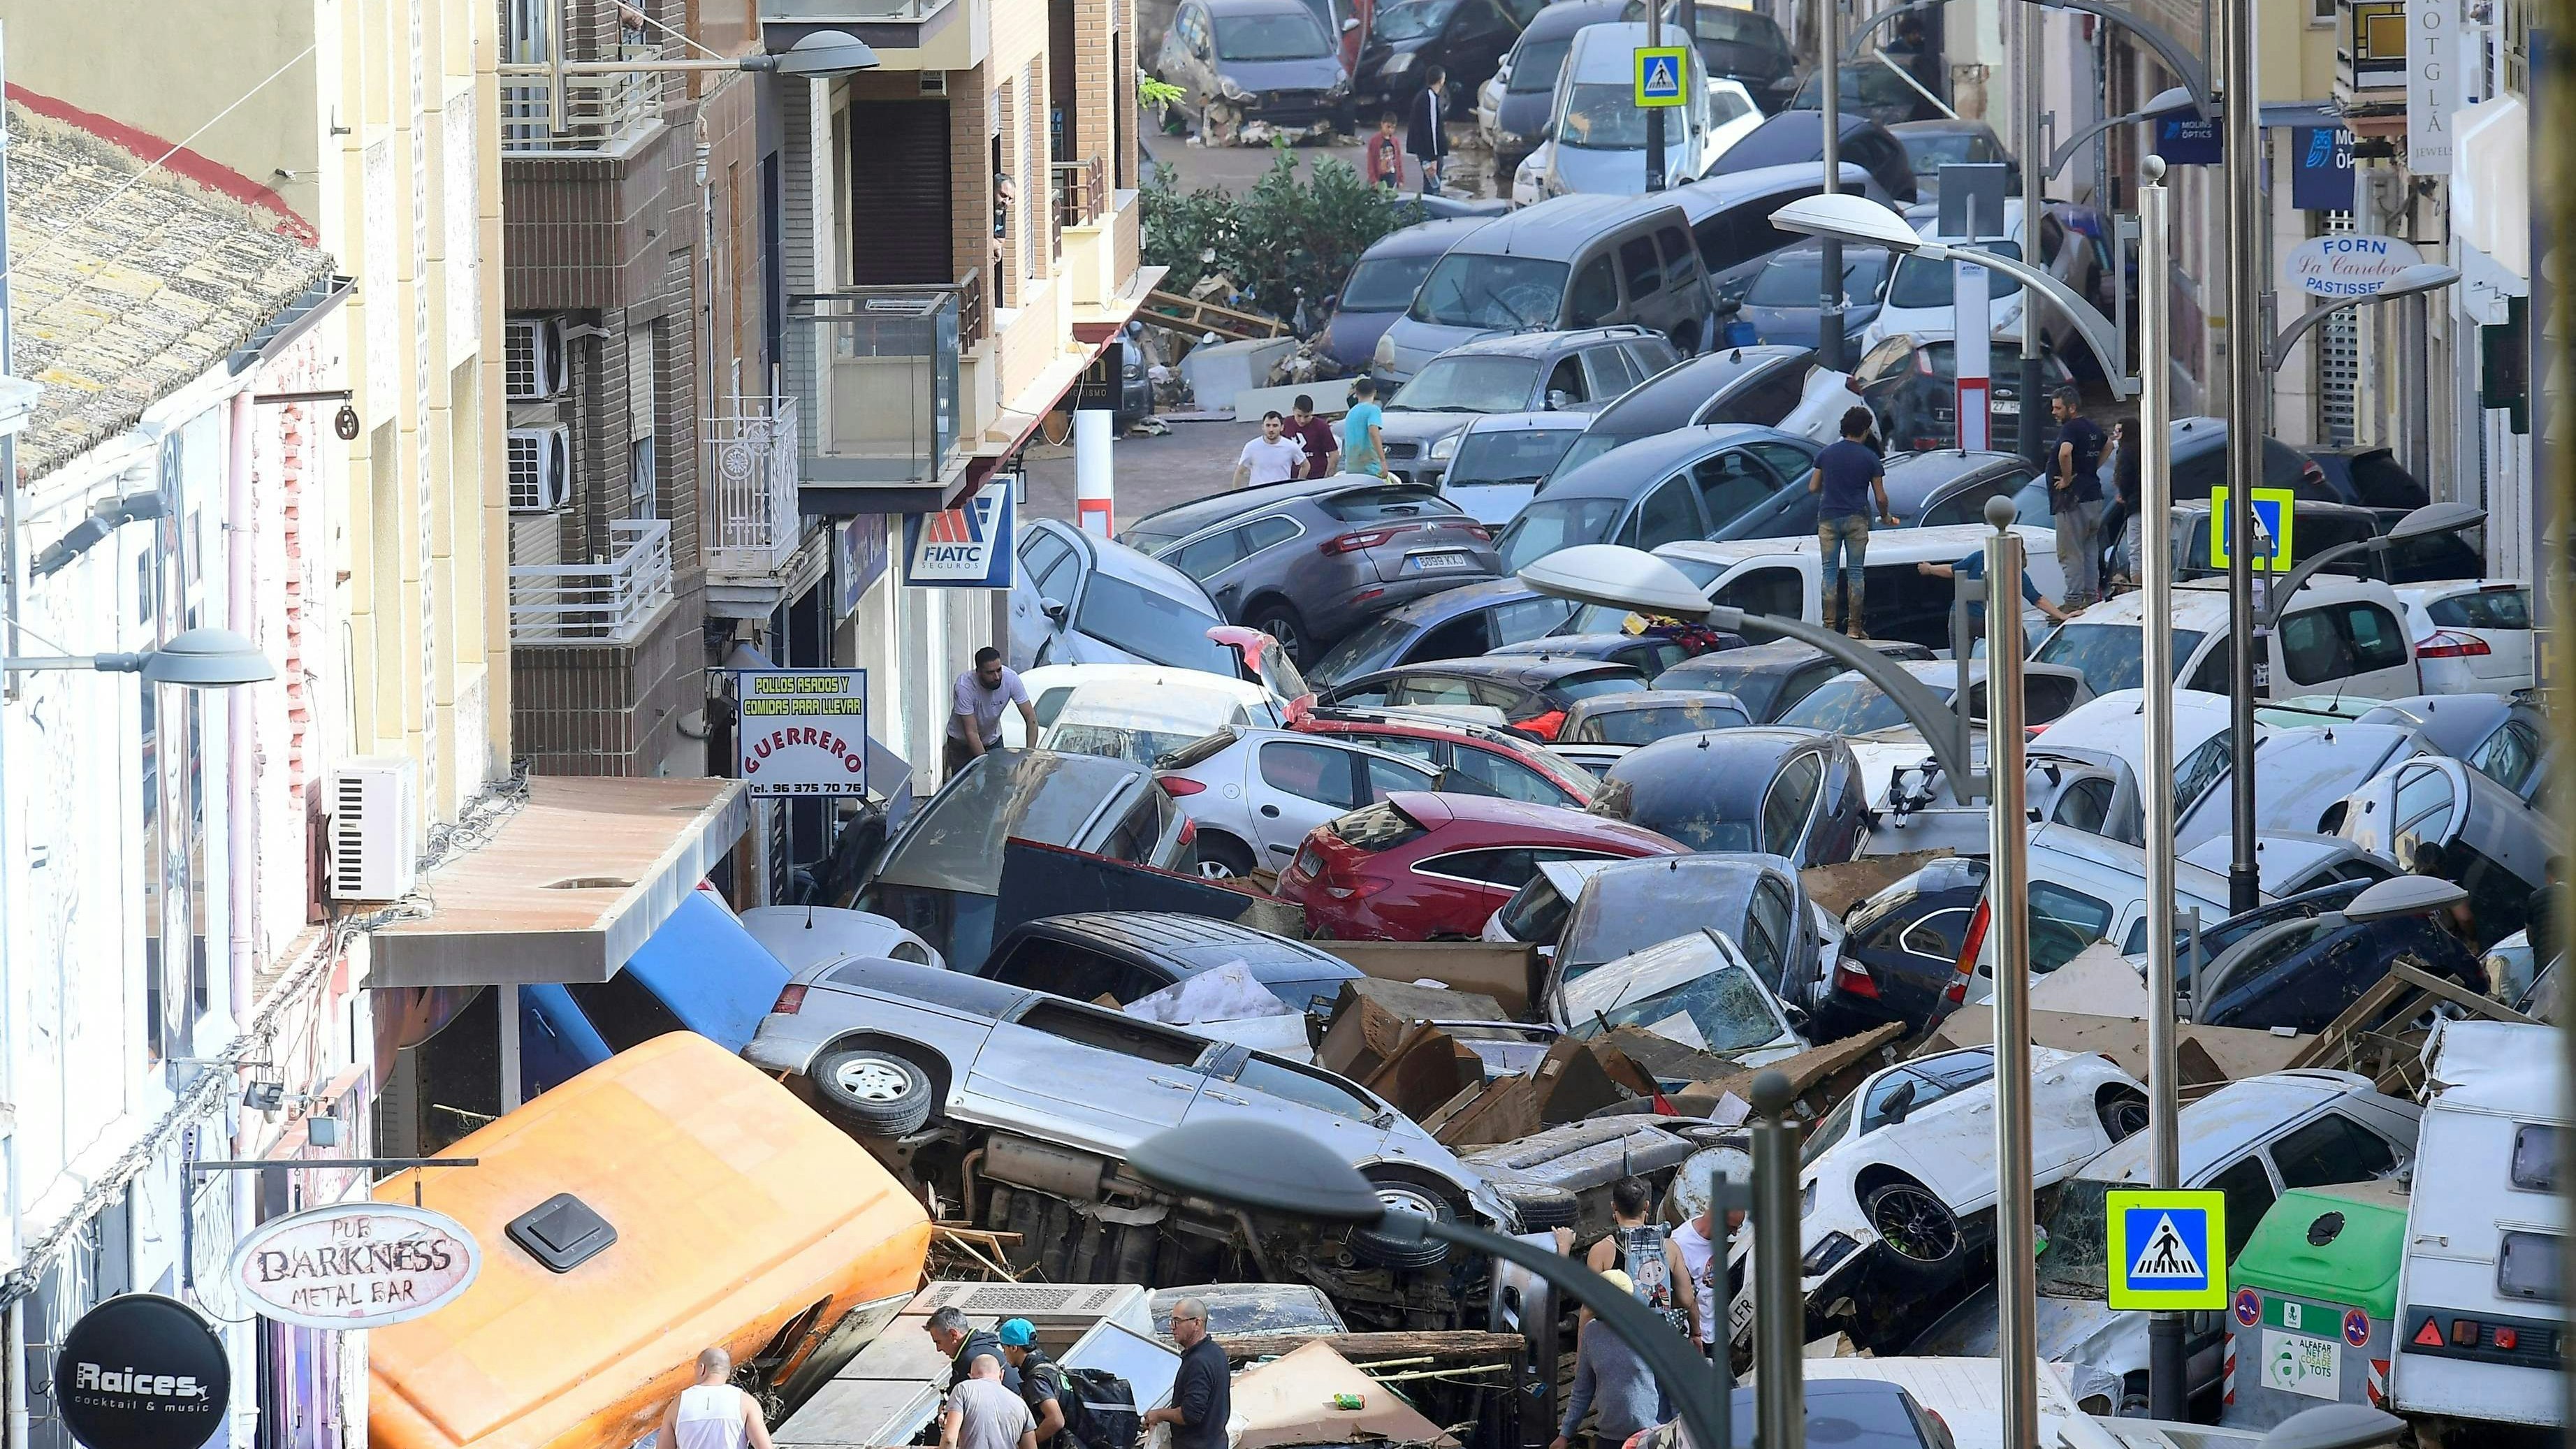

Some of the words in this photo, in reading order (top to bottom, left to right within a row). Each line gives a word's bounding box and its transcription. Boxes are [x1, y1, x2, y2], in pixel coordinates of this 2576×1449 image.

[2422, 0, 2442, 133] OTGLÁ
[2323, 240, 2387, 254] FORN
[2297, 256, 2322, 274] La
[924, 546, 981, 561] FIATC
[1420, 557, 1443, 566] 8099
[755, 677, 794, 694] POLLOS
[796, 677, 838, 693] ASADOS
[839, 676, 850, 693] Y
[743, 699, 789, 715] COMIDAS
[792, 699, 820, 715] PARA
[822, 698, 861, 715] LLEVAR
[745, 727, 861, 773] GUERRERO
[750, 784, 768, 793] Tel.
[773, 784, 789, 792] 96
[794, 784, 819, 792] 375
[823, 784, 841, 792] 70
[845, 784, 861, 792] 76
[332, 1218, 371, 1242] PUB
[257, 1239, 451, 1283] DARKNESS
[291, 1283, 363, 1311] METAL
[371, 1280, 417, 1303] BAR
[1729, 1299, 1754, 1328] LFR
[2299, 1339, 2331, 1353] ALFAFAR
[76, 1362, 197, 1397] Raices
[2310, 1364, 2331, 1377] TOTS
[74, 1396, 137, 1410] cocktail
[146, 1401, 154, 1411] &
[165, 1403, 209, 1412] music
